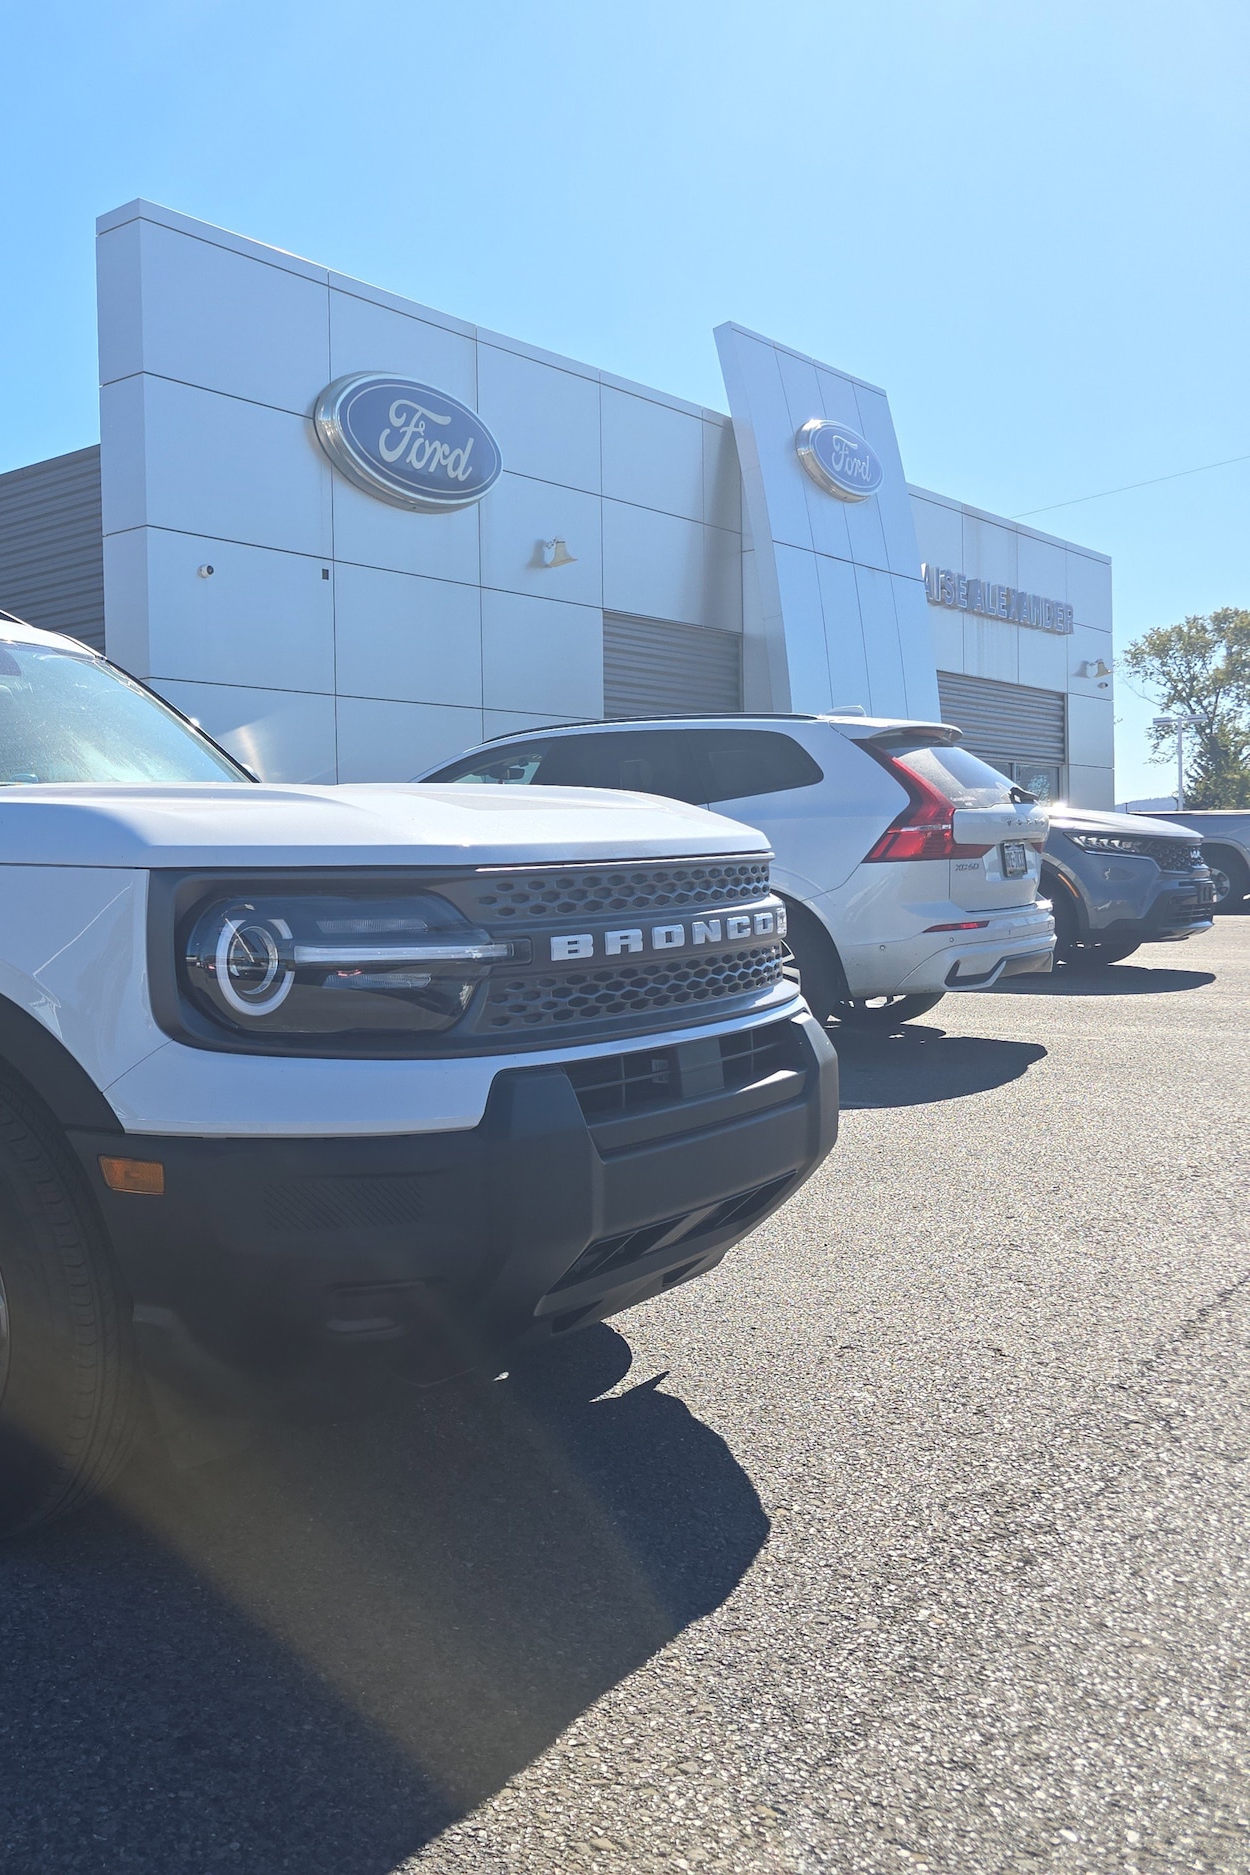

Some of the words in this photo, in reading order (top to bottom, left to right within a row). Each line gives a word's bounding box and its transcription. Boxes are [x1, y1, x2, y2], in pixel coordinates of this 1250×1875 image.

[378, 399, 475, 482] Ford
[831, 434, 872, 482] Ford
[968, 577, 1074, 635] ALEXANDER
[550, 911, 774, 961] BRONCO
